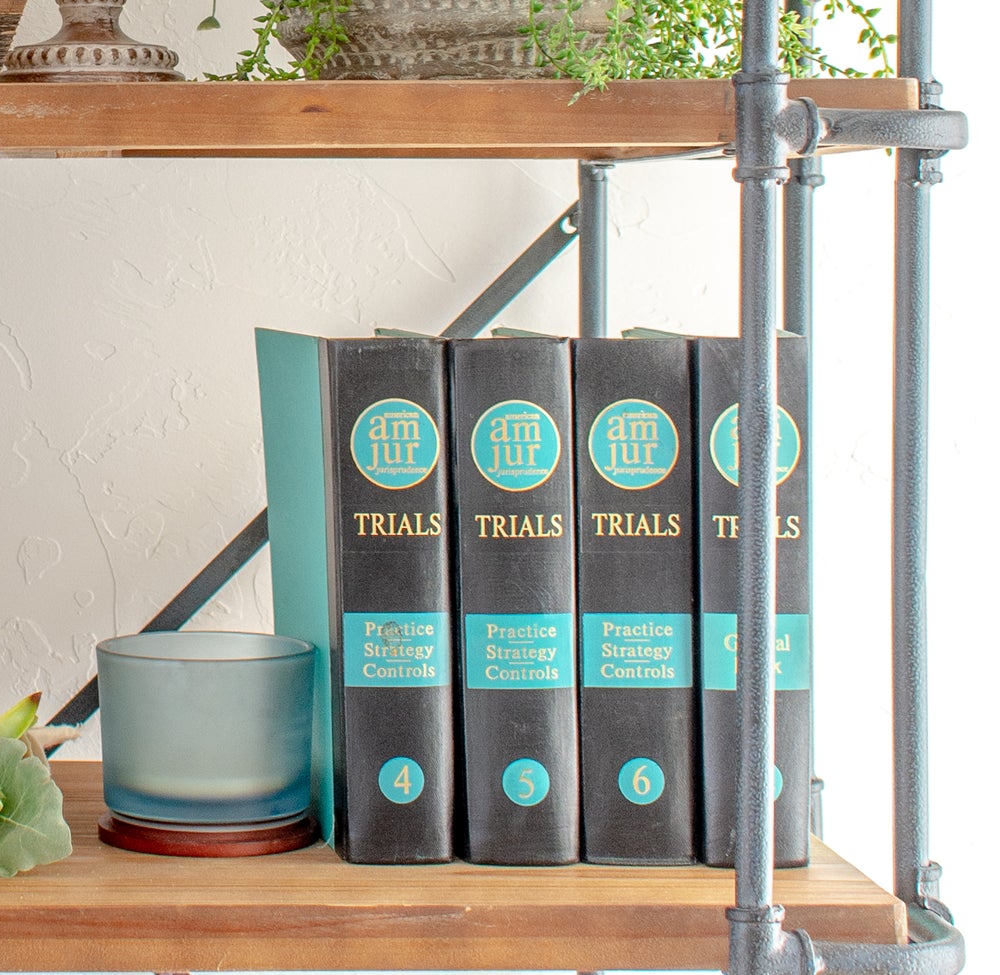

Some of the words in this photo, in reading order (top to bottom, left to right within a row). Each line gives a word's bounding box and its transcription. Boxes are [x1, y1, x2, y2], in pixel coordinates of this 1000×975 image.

[368, 415, 421, 441] am
[504, 411, 541, 421] american
[606, 415, 659, 441] am
[489, 417, 542, 443] am
[366, 441, 420, 471] jur
[487, 443, 541, 473] jur
[604, 441, 659, 471] jur
[353, 512, 442, 536] TRIALS
[474, 514, 564, 538] TRIALS
[591, 513, 681, 537] TRIALS
[364, 621, 435, 637] Practice
[486, 623, 558, 639] Practice
[602, 621, 674, 637] Practice
[363, 642, 434, 659] Strategy
[486, 644, 557, 661] Strategy
[601, 642, 673, 660] Strategy
[362, 662, 436, 678] Controls
[485, 665, 559, 680] Controls
[600, 663, 675, 679] Controls
[393, 765, 412, 795] 4
[518, 768, 535, 800] 5
[632, 764, 651, 796] 6
